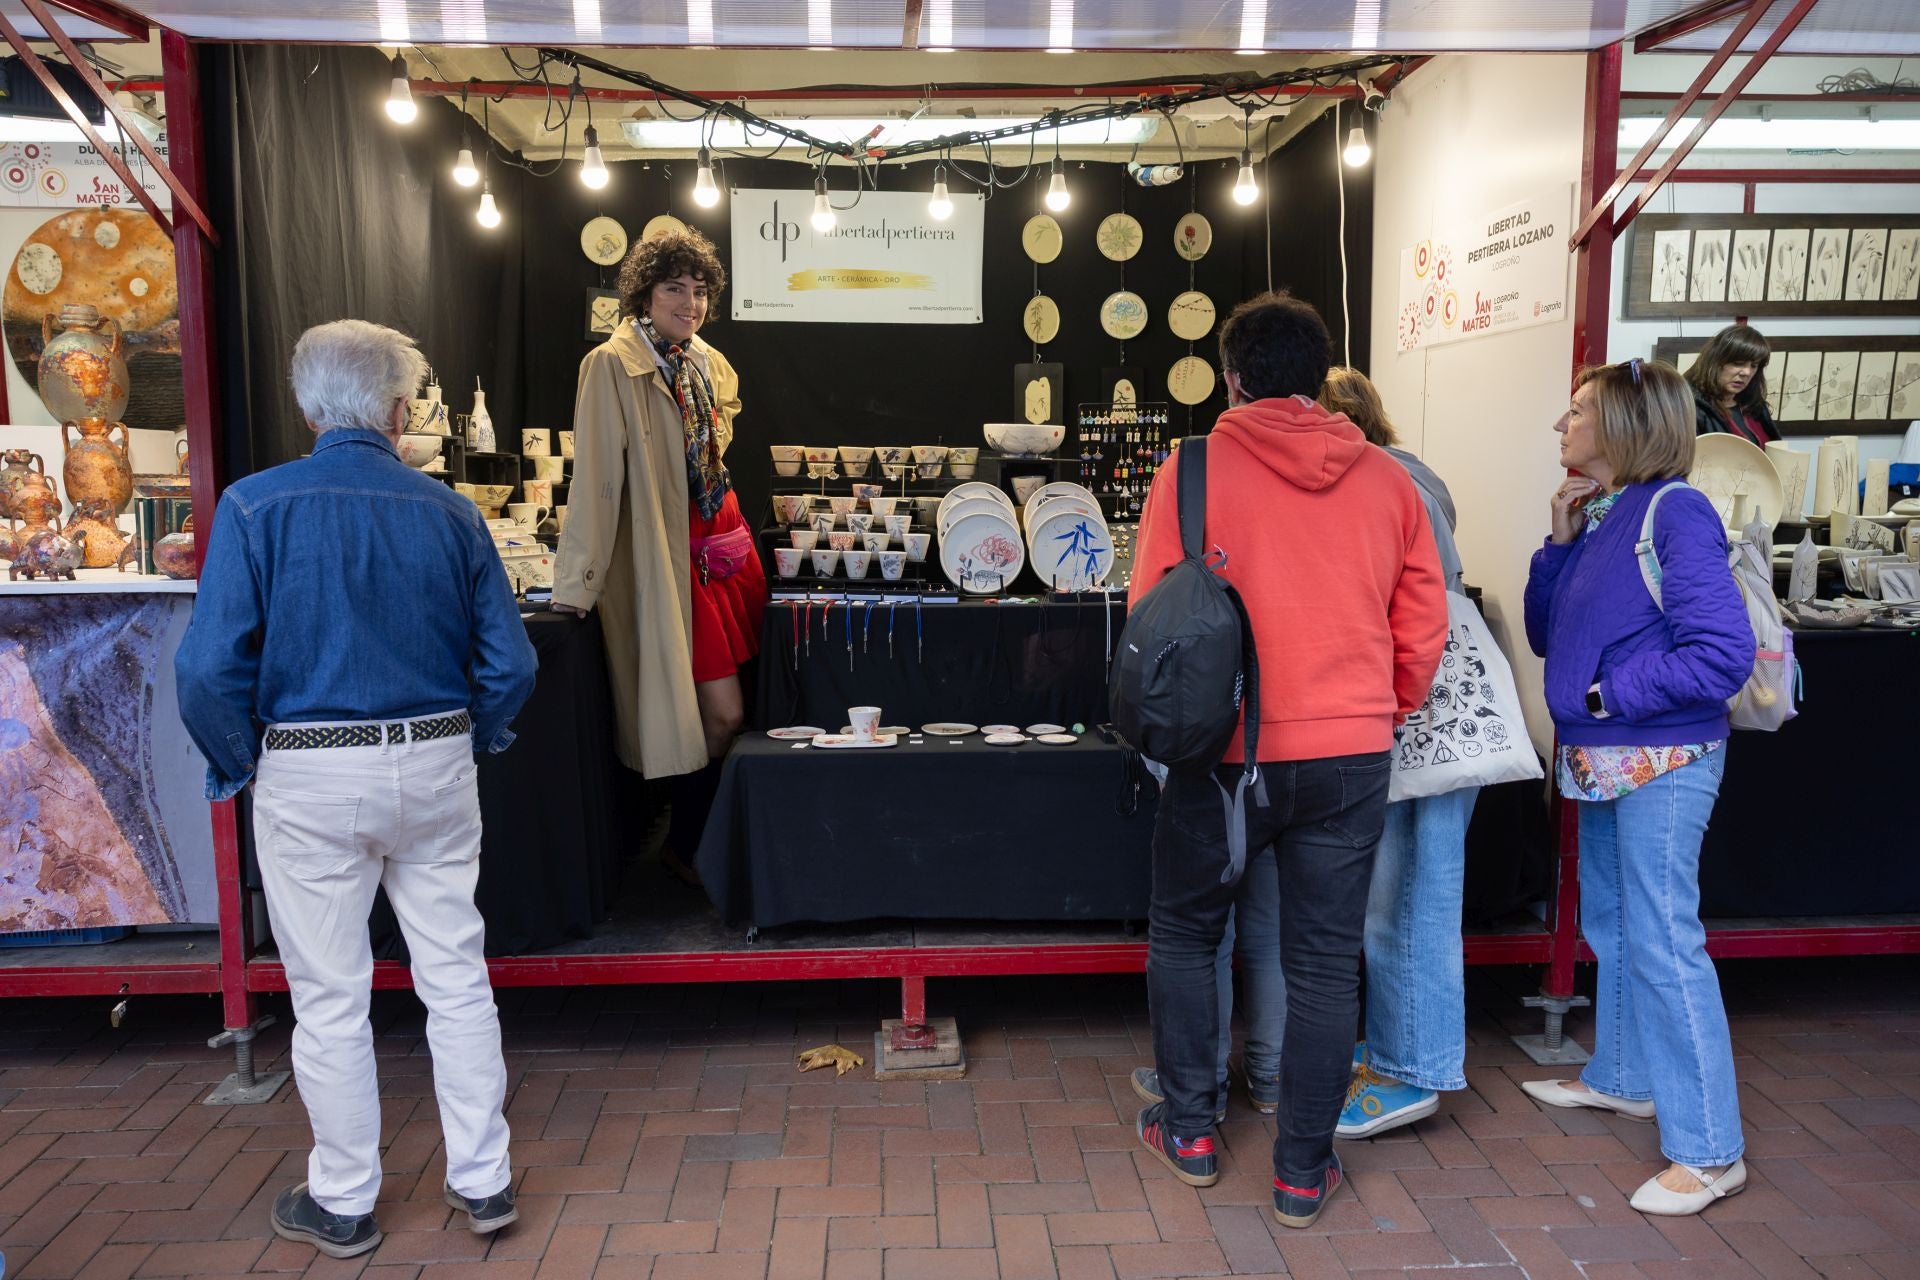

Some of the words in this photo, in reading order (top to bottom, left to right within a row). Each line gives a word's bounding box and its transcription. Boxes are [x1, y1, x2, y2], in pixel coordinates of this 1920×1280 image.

[93, 176, 119, 193] SAN
[77, 194, 120, 204] MATEO
[760, 199, 801, 263] dp
[1487, 211, 1531, 237] LIBERTAD
[1468, 238, 1511, 264] PERTIERRA
[1513, 223, 1554, 249] LOZANO
[1475, 290, 1492, 316] SAN
[1493, 291, 1519, 305] LOGROÑO
[1540, 300, 1562, 314] Logroño
[1462, 314, 1492, 333] MATEO
